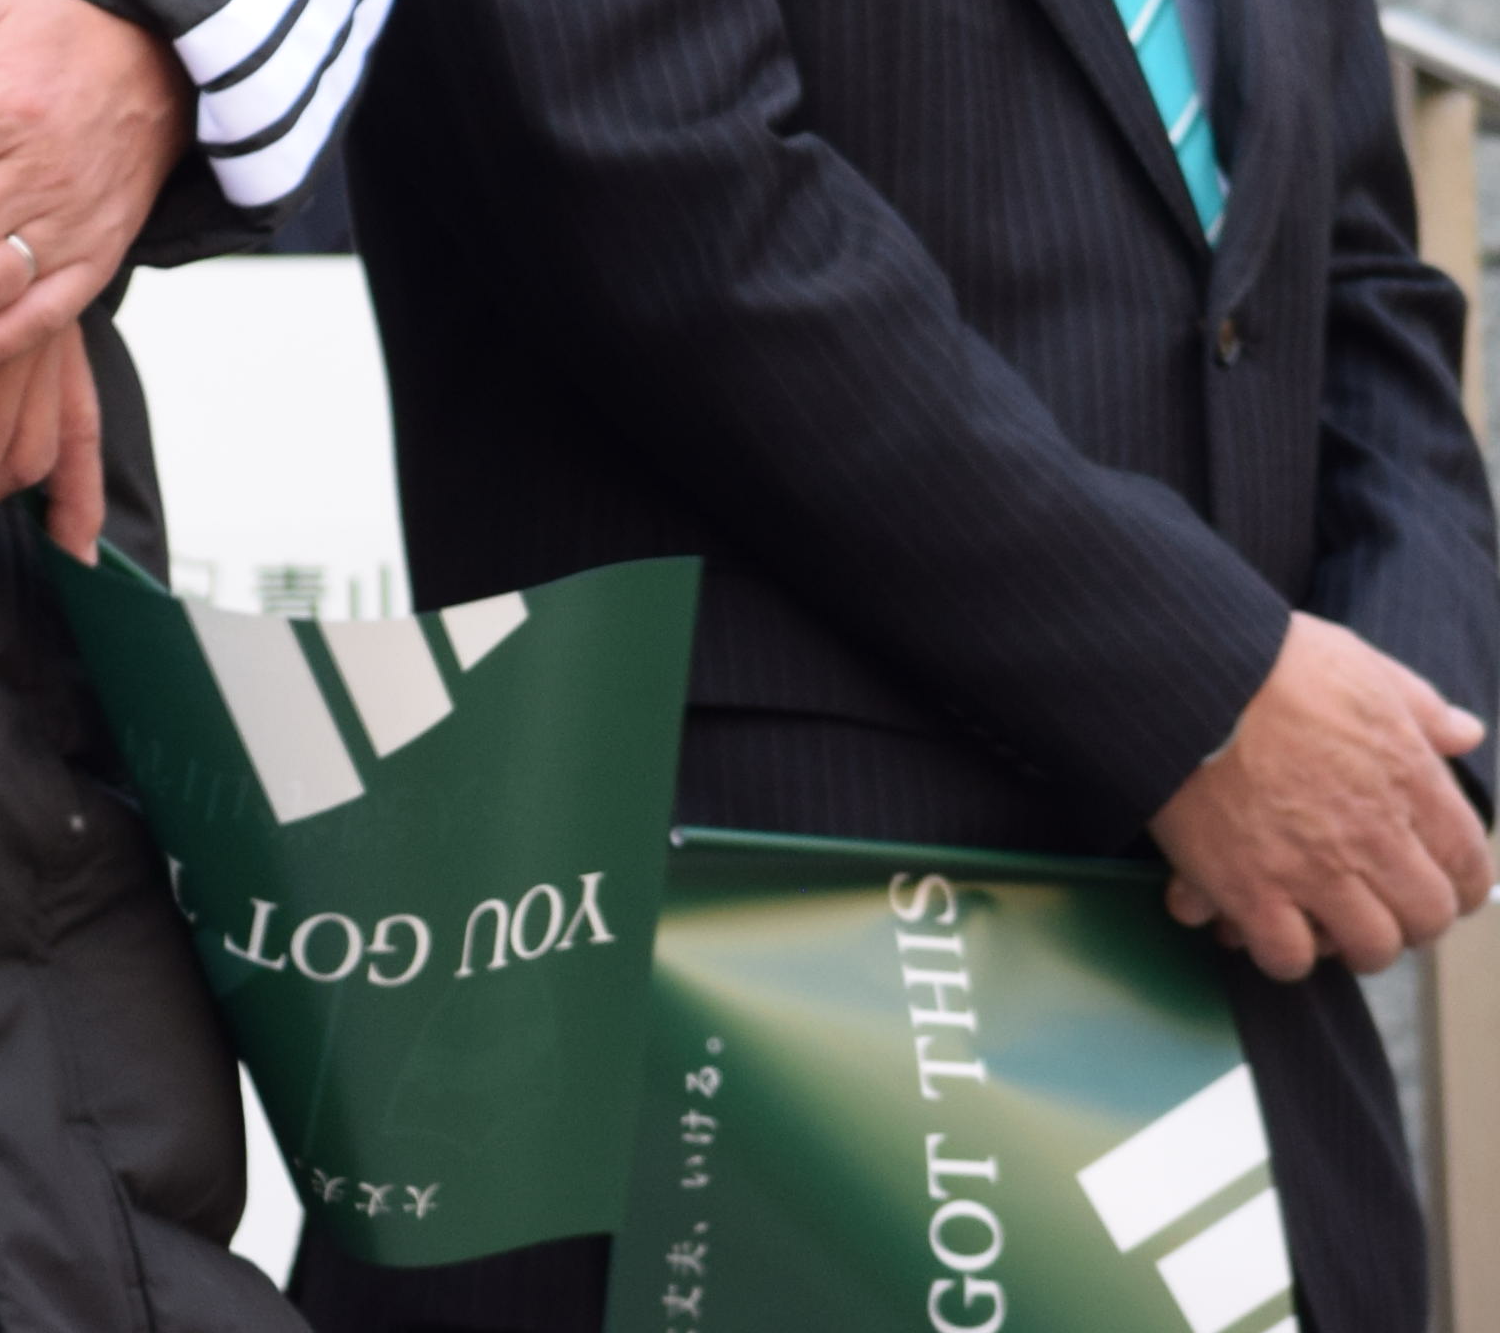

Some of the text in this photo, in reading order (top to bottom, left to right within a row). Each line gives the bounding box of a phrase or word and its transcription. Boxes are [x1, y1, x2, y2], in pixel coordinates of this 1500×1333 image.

[223, 871, 616, 987] YOU GOT
[661, 1035, 726, 1333] 丈夫、いける。
[889, 872, 1007, 1333] GOT THIS
